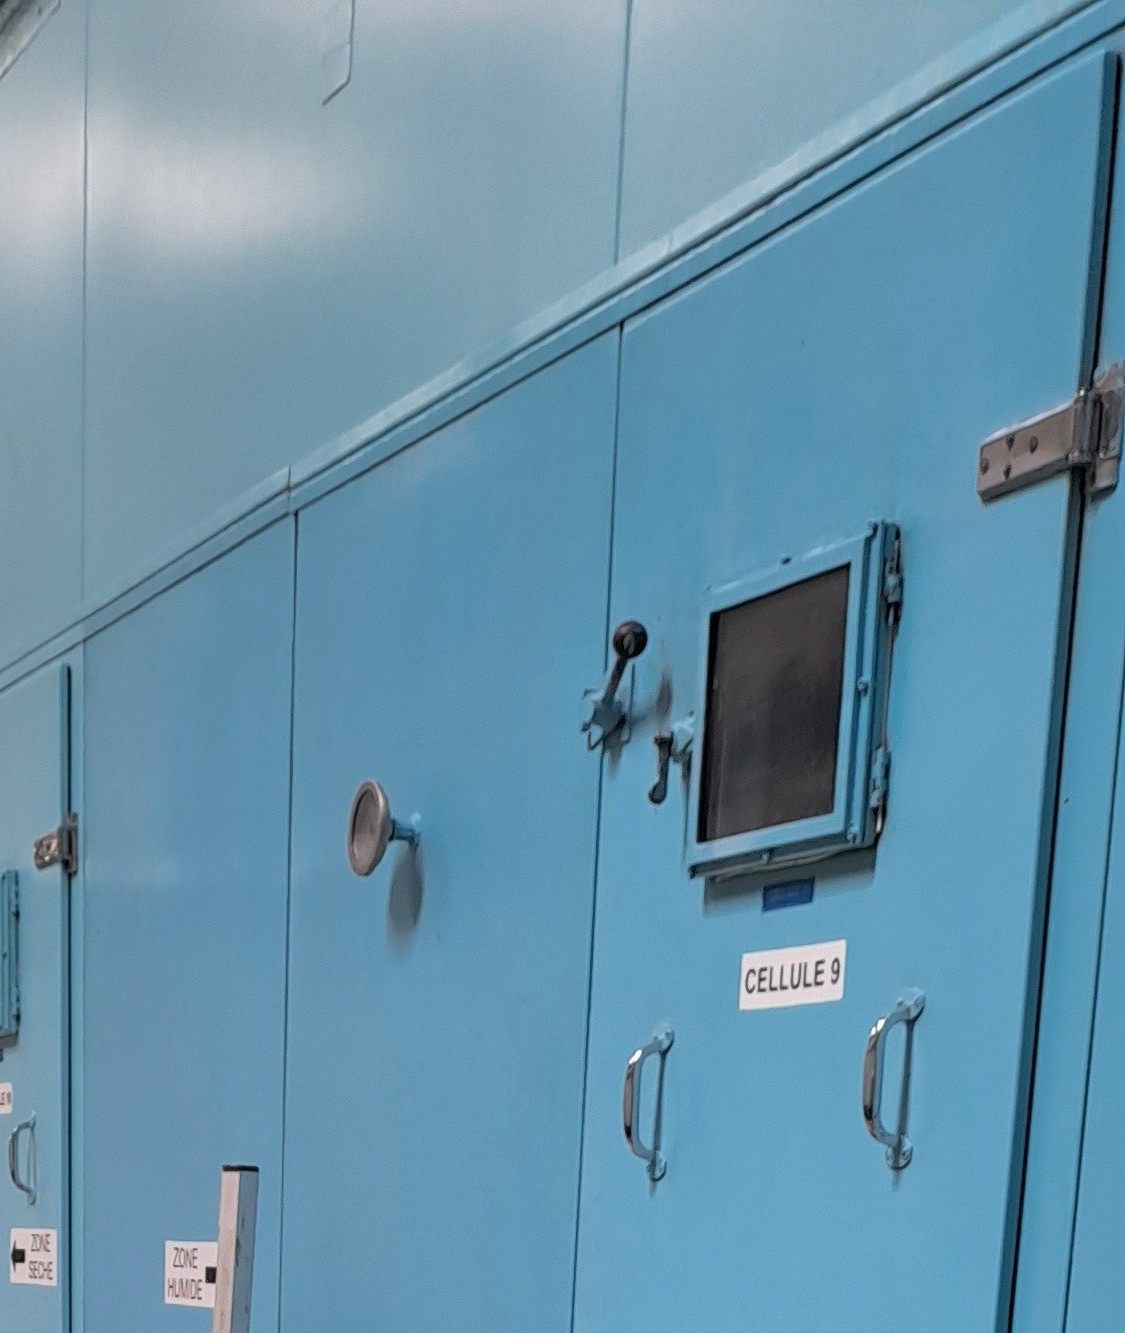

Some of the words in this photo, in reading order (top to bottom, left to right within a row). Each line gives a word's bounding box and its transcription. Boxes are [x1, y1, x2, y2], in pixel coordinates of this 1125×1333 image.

[744, 959, 826, 994] CELLULE
[831, 957, 841, 985] 9
[30, 1233, 51, 1252] ZONE
[173, 1246, 198, 1269] ZONE
[167, 1277, 203, 1300] HUMIDE
